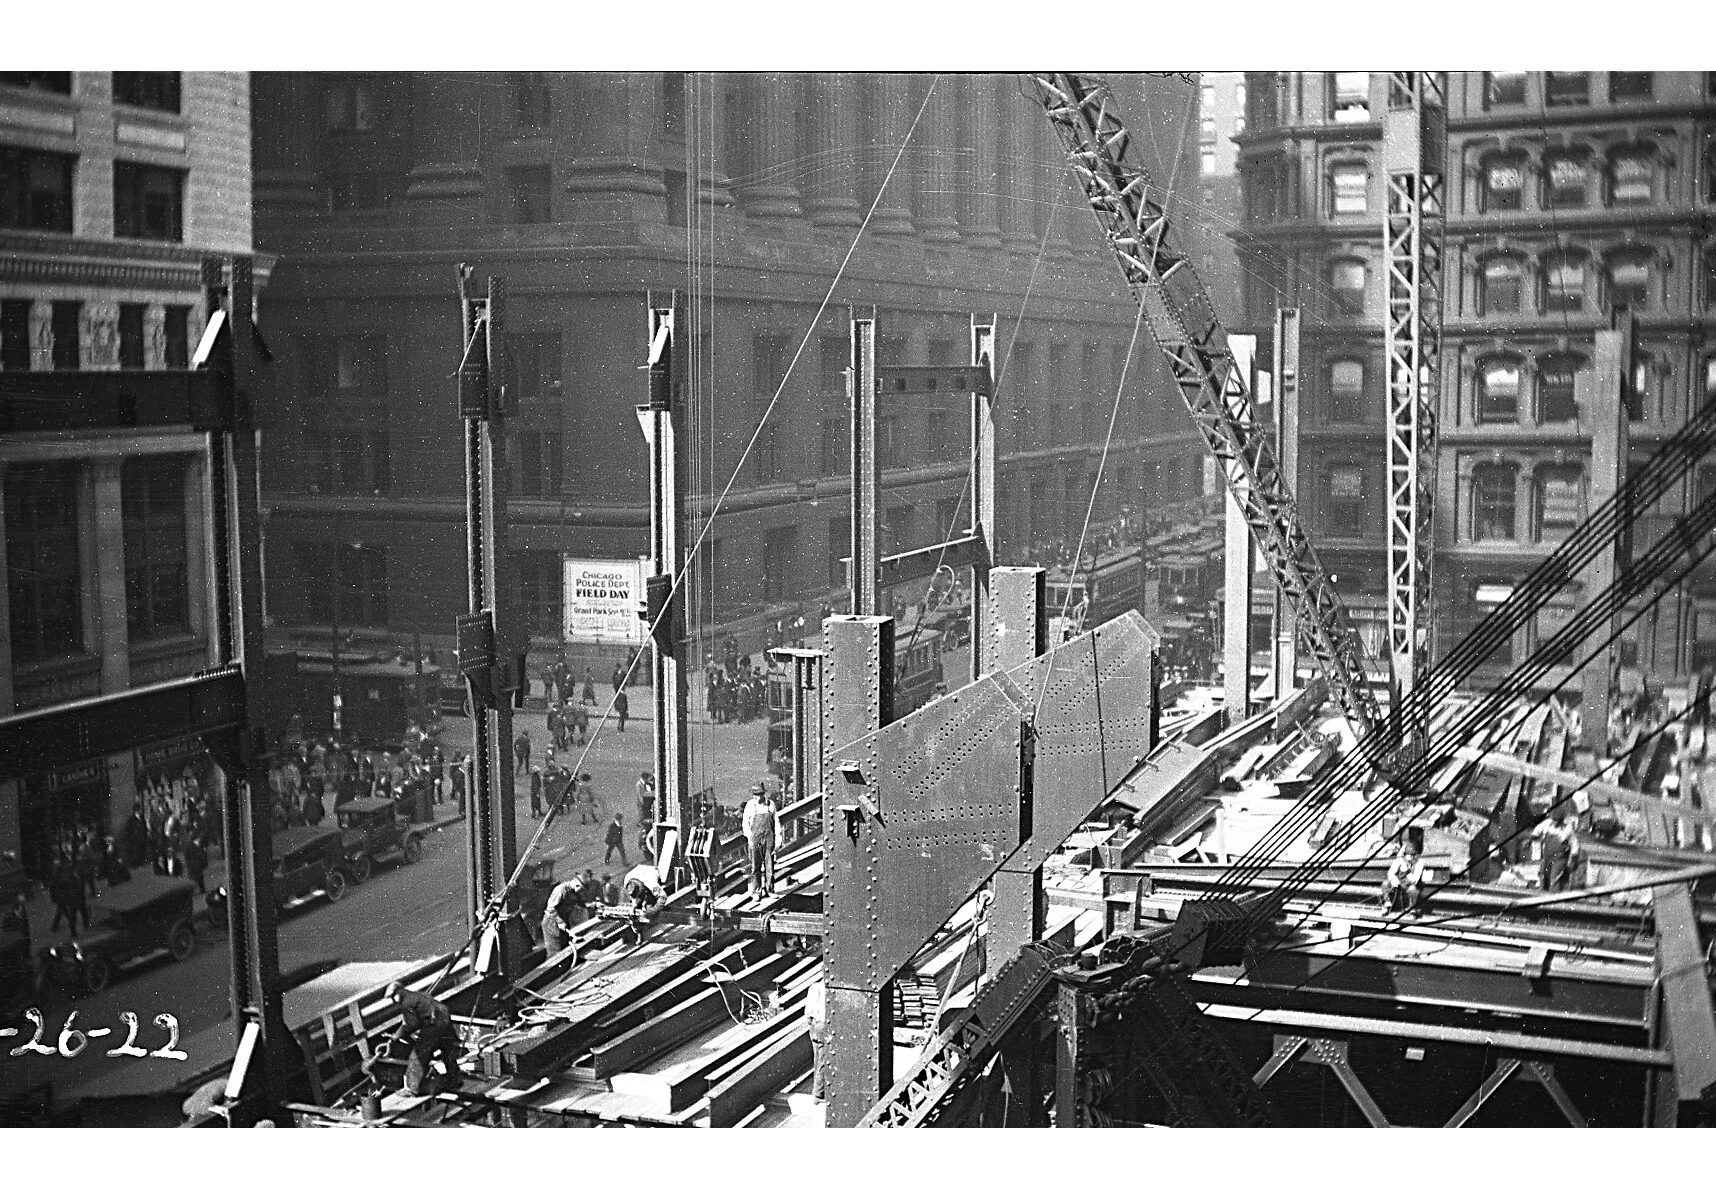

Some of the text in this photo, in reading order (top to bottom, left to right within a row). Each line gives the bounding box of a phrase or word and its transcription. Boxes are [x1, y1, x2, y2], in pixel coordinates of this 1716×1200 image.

[582, 571, 622, 580] CHICAGO
[576, 578, 606, 587] POLICE
[576, 589, 630, 599] FIELD DAY
